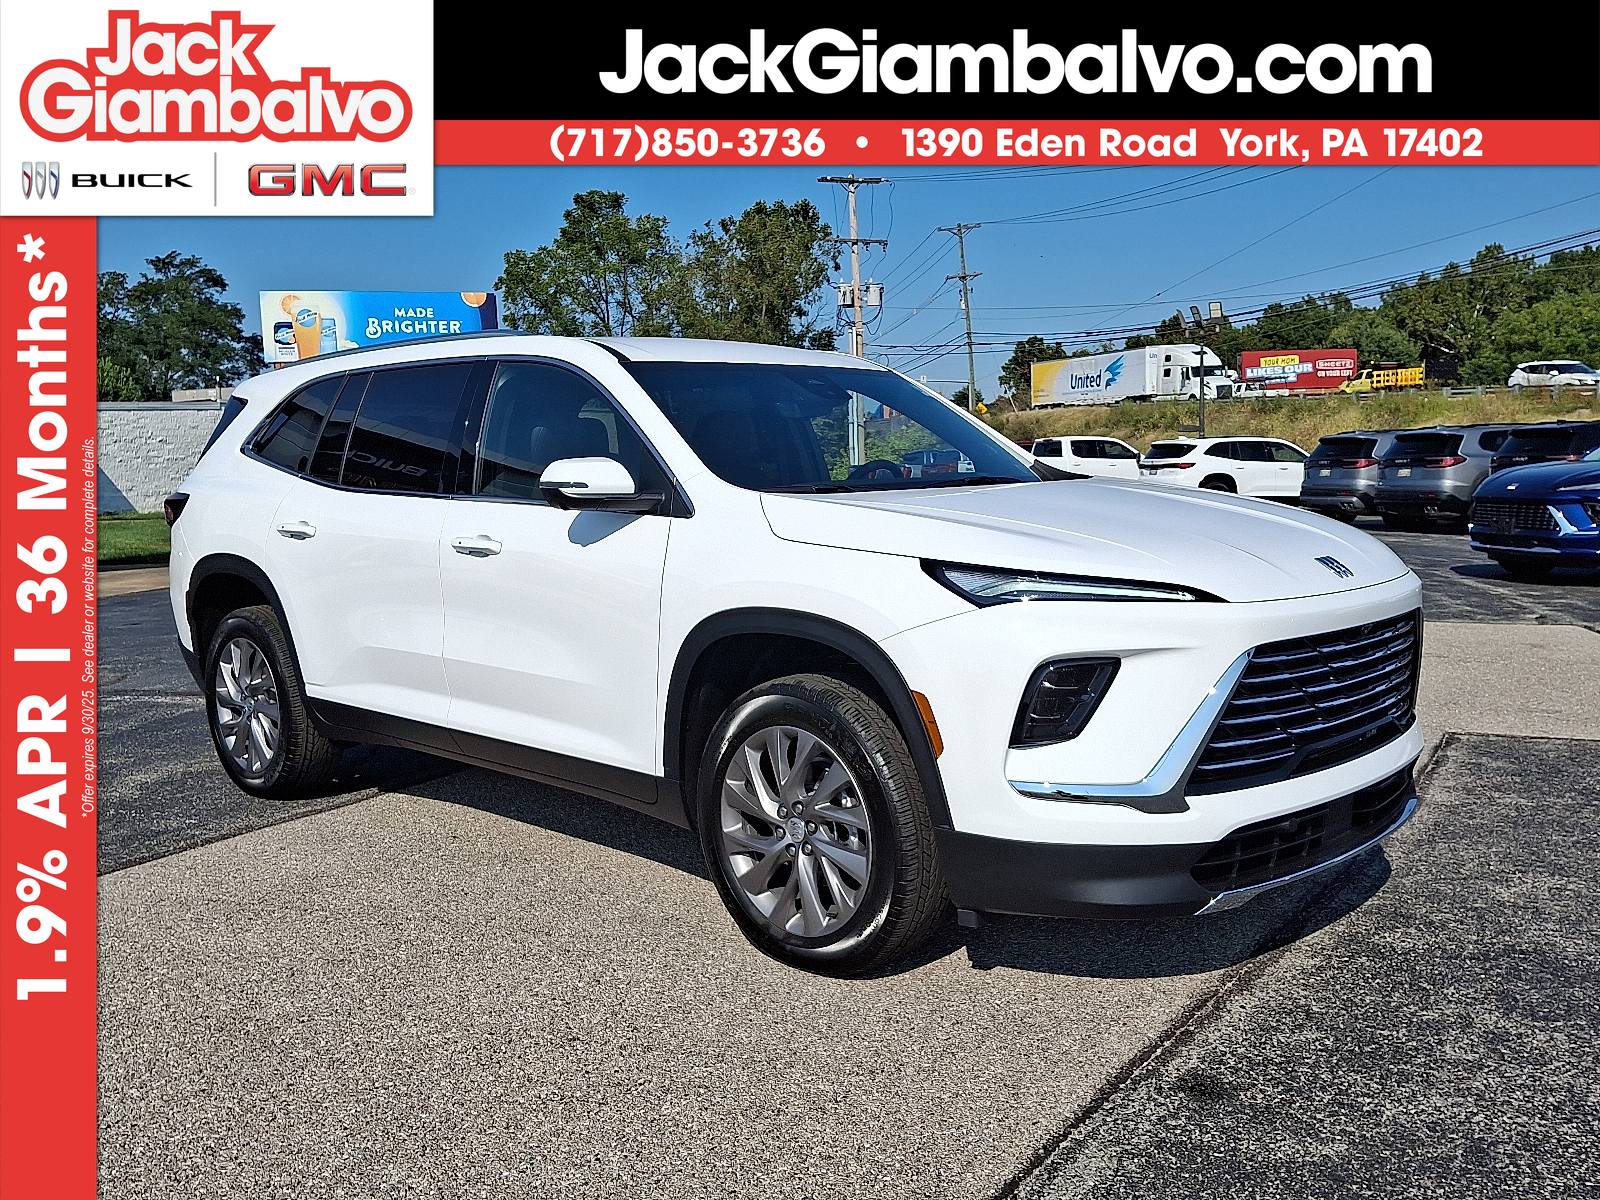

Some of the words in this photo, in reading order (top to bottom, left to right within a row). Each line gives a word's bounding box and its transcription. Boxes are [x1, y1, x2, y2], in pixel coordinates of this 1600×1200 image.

[394, 307, 434, 318] MADE
[365, 317, 461, 339] BRIGHTER
[1264, 358, 1279, 366] YOUR
[1246, 367, 1283, 378] LIKES
[1284, 363, 1314, 374] OUR
[1069, 368, 1102, 390] United
